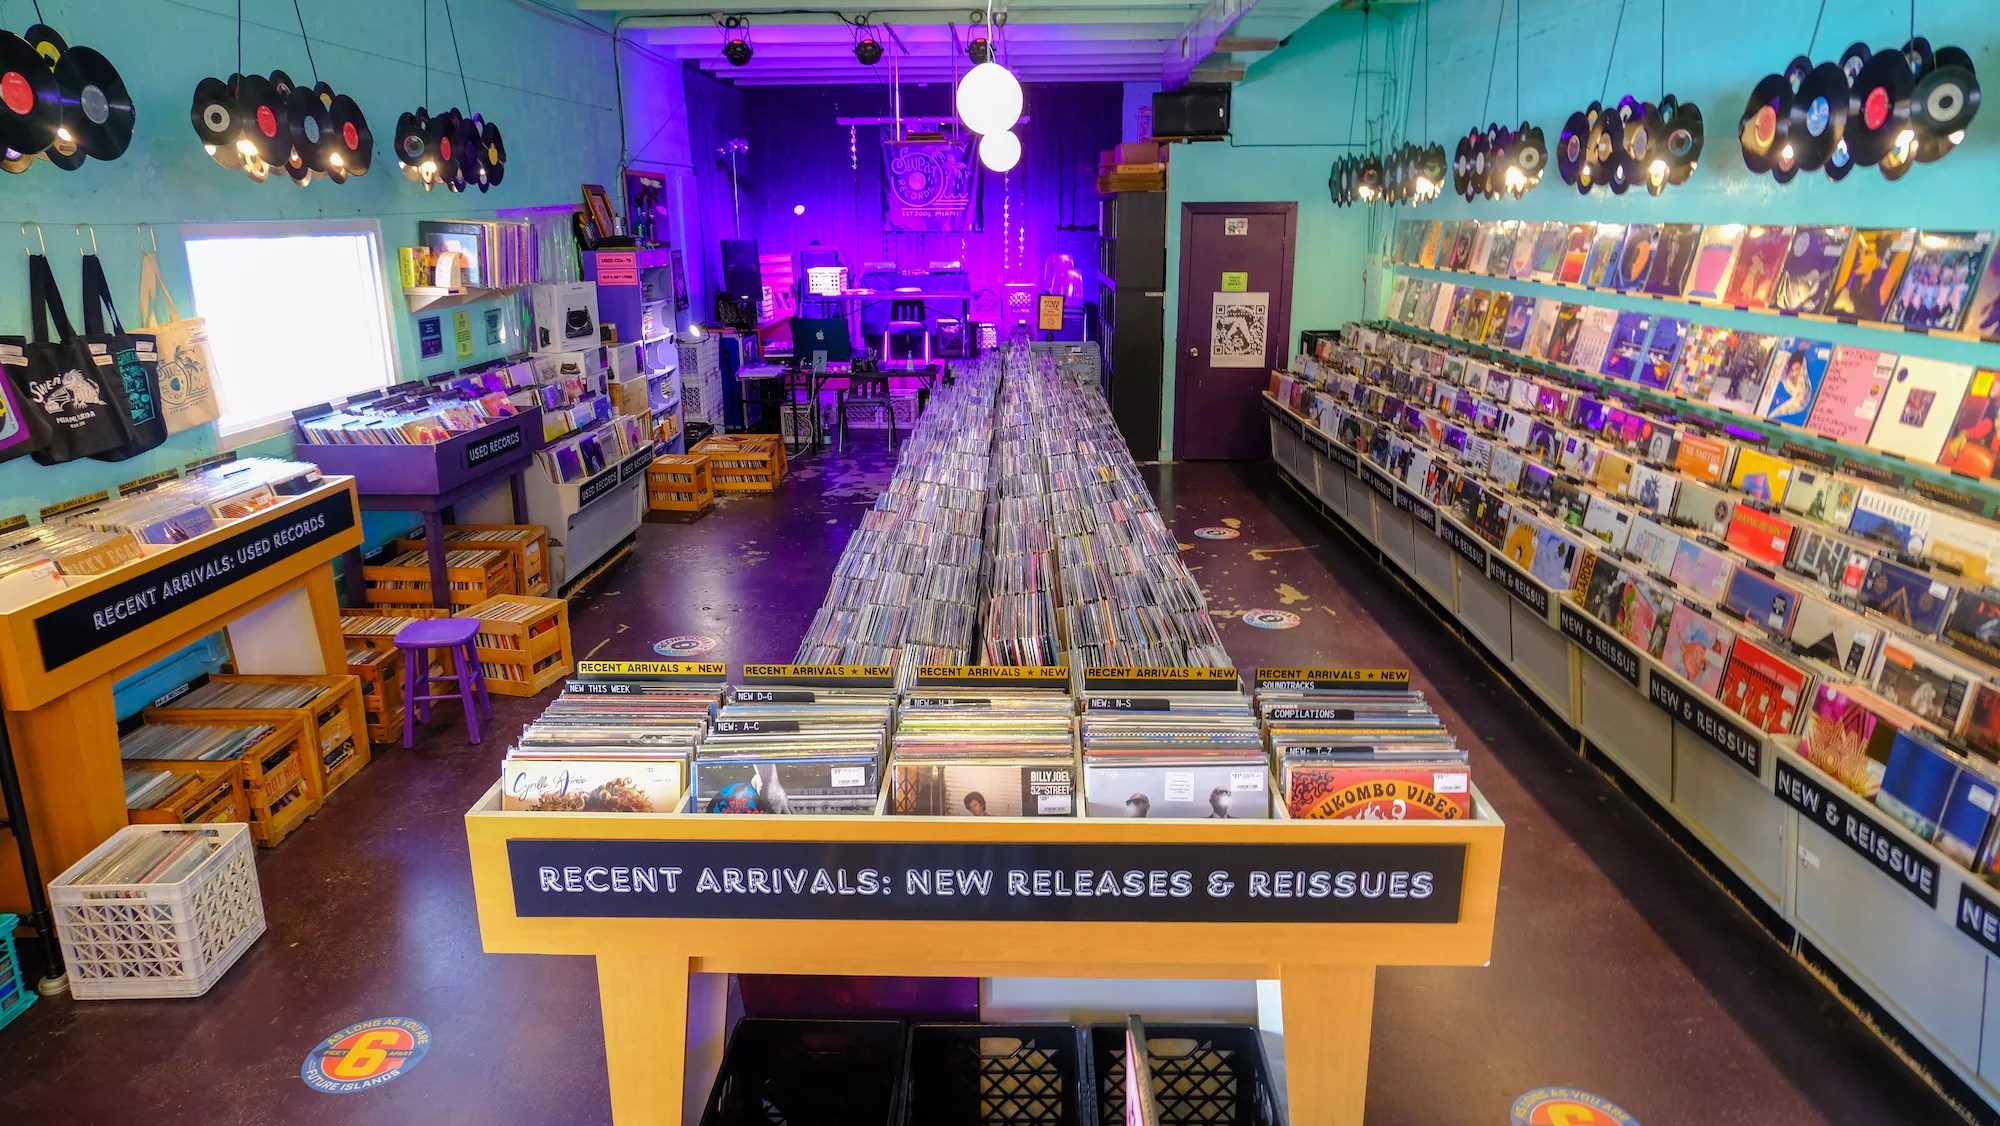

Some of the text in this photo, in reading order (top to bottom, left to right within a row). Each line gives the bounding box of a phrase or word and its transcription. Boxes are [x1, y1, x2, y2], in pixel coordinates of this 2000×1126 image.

[897, 180, 935, 200] RECORDS
[469, 433, 520, 461] USED RECORDS
[622, 452, 653, 477] USED RECORDS
[119, 482, 137, 490] RECENT
[138, 473, 160, 485] ARRIVALS
[581, 472, 617, 501] USED RECORDS
[40, 490, 108, 516] RECENT ARRIVALS USED
[11, 515, 26, 527] USED
[1441, 523, 1484, 568] NEW & REISSUE
[93, 513, 326, 631] RECENT ARRIVALS: USED RECORDS
[1490, 561, 1545, 611] NEW & REISSUE
[1561, 612, 1636, 679] NEW & REISSUE
[581, 663, 724, 673] RECENT ARRIVALS NEW
[746, 666, 890, 676] RECENT ARRIVALS NEW
[920, 667, 1066, 677] RECENT ARRIVALS NEW
[1088, 668, 1235, 678] RECENT ARRIVALS NEW
[1259, 670, 1407, 680] RECENT ARRIVALS NEW
[568, 684, 631, 693] NEW THIS WEEK
[1262, 681, 1315, 690] SOUNDTRACKS
[738, 693, 773, 701] NEW D-G
[1091, 699, 1131, 708] NEW: N-S
[1274, 710, 1335, 719] COMPILATIONS
[1651, 676, 1756, 767] NEW & REISSUE
[718, 722, 760, 731] NEW: A-C
[1289, 747, 1310, 756] NEW:
[1030, 771, 1070, 782] BILLY JOEL
[1044, 786, 1070, 795] STREET
[1407, 785, 1457, 819] VIBES
[1778, 772, 1933, 896] NEW & REISSUE
[538, 865, 1434, 898] RECENT ARRIVALS: NEW RELEASES & REISSUES
[1962, 897, 2000, 943] NE
[327, 1018, 429, 1045] AS LONG AS YOU ARE
[334, 1031, 400, 1077] 6
[306, 1068, 400, 1091] FUTURE ISLANDS
[1572, 1091, 1600, 1106] YOU
